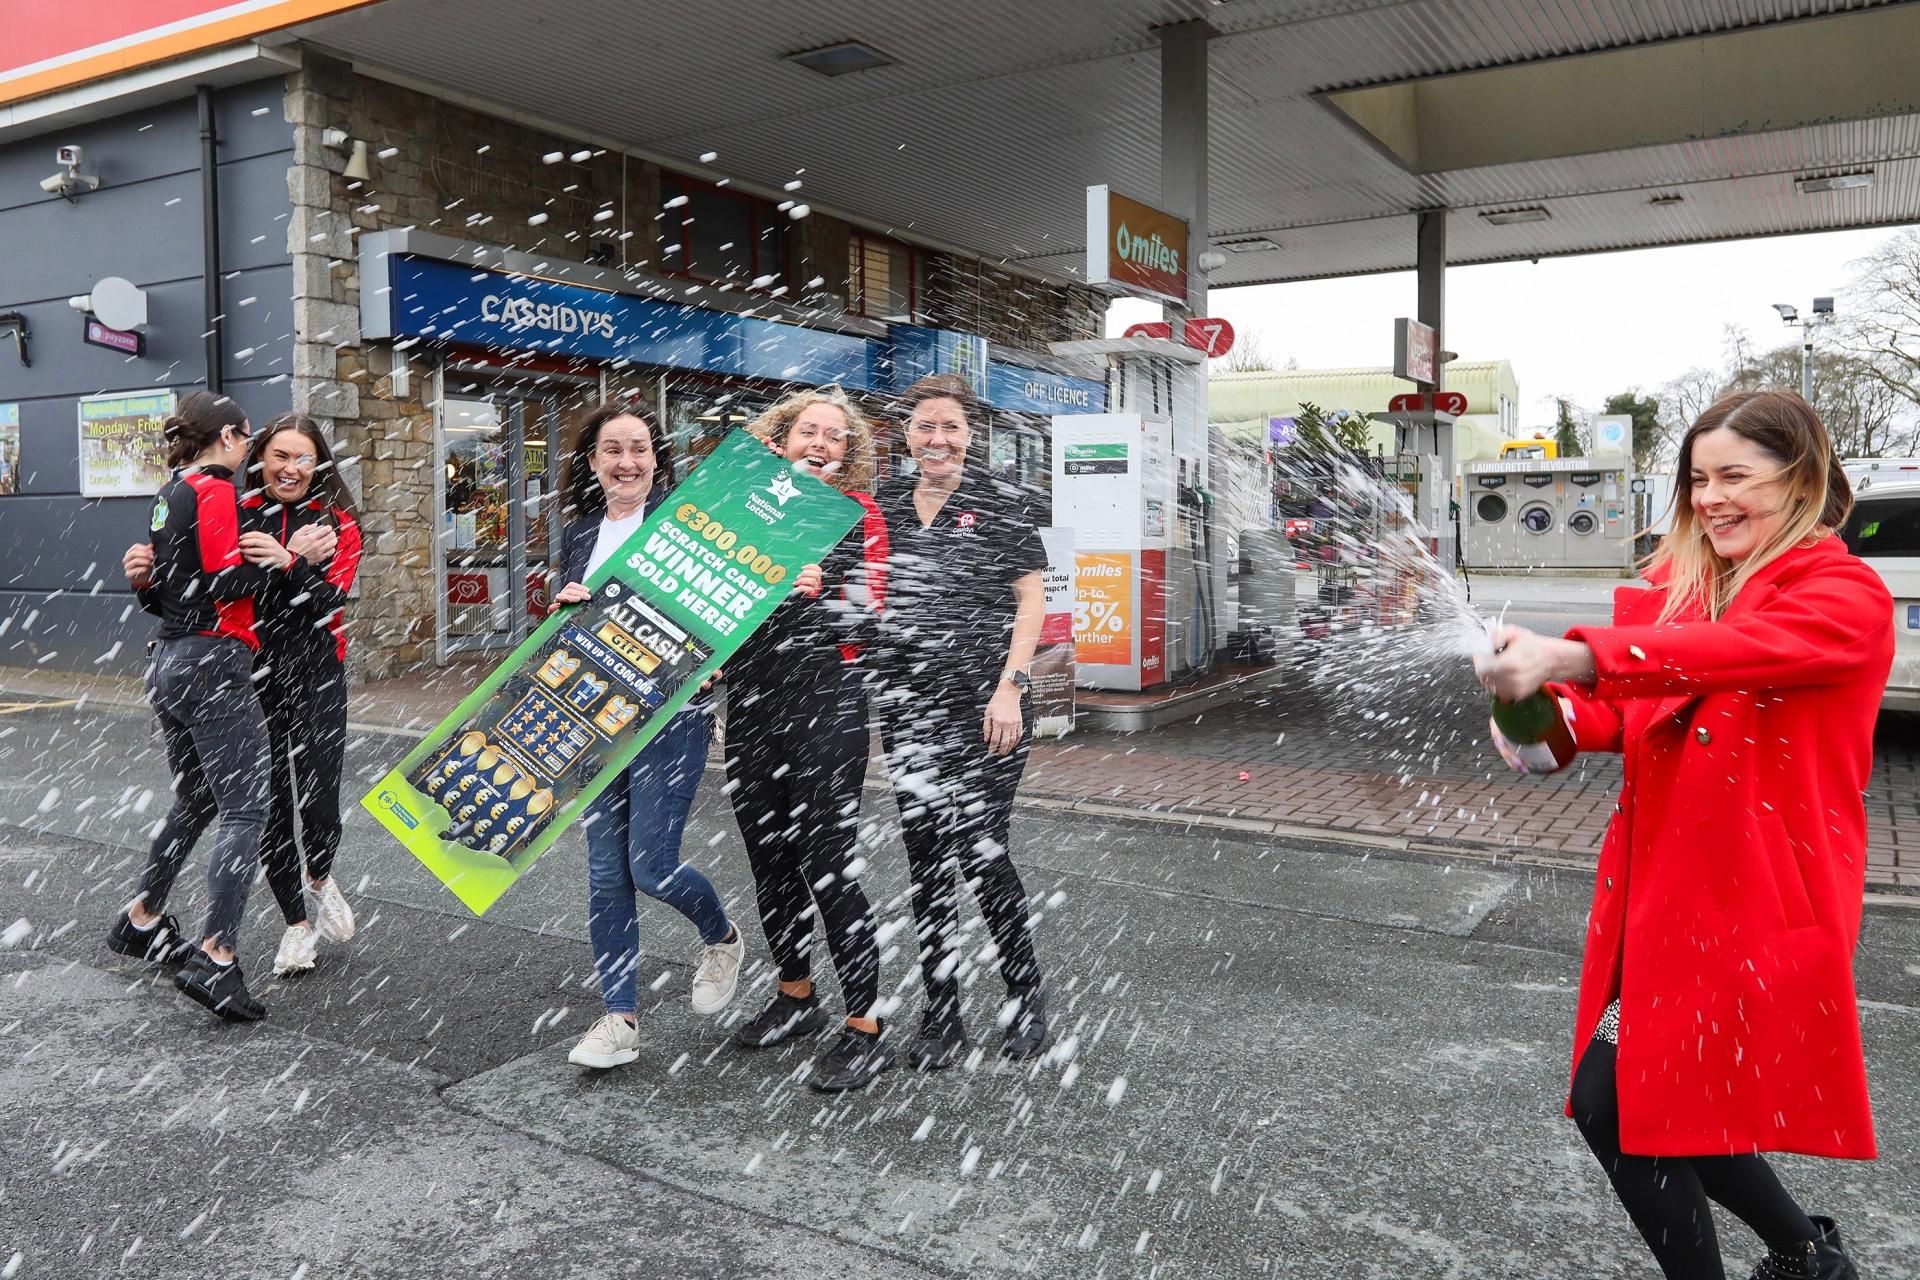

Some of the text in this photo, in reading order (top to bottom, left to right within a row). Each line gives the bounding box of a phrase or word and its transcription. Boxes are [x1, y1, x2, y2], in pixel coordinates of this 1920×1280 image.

[1131, 233, 1179, 275] miles
[481, 295, 614, 339] CASSIDY'S
[105, 331, 135, 347] payzone
[1203, 324, 1223, 353] 7
[1024, 381, 1088, 407] OFF LICENCE
[84, 398, 157, 418] Opening Hours
[1398, 396, 1461, 414] 1 2
[89, 420, 129, 436] Monday
[107, 438, 122, 452] 6am
[524, 449, 543, 462] ATM
[1472, 460, 1589, 473] LAUNDERETTE REVOLUTION
[745, 500, 777, 526] Lottery
[748, 492, 786, 521] National
[1559, 523, 1565, 533] 2
[1599, 523, 1605, 533] 3
[675, 503, 787, 584] €300,000
[659, 521, 767, 600] SCRATCH CARD
[643, 532, 753, 620] WINNER
[1052, 574, 1069, 582] total
[1082, 564, 1122, 577] miles
[608, 585, 618, 596] €15
[626, 552, 738, 637] SOLD HERE!
[1044, 584, 1067, 593] nsport
[1091, 587, 1104, 599] to
[1075, 601, 1123, 632] 3%
[602, 602, 685, 667] ALL CASH
[1075, 632, 1113, 644] urther
[611, 633, 648, 661] GIFT
[575, 633, 652, 696] WIN UP TO €300,000
[384, 795, 393, 805] 18+
